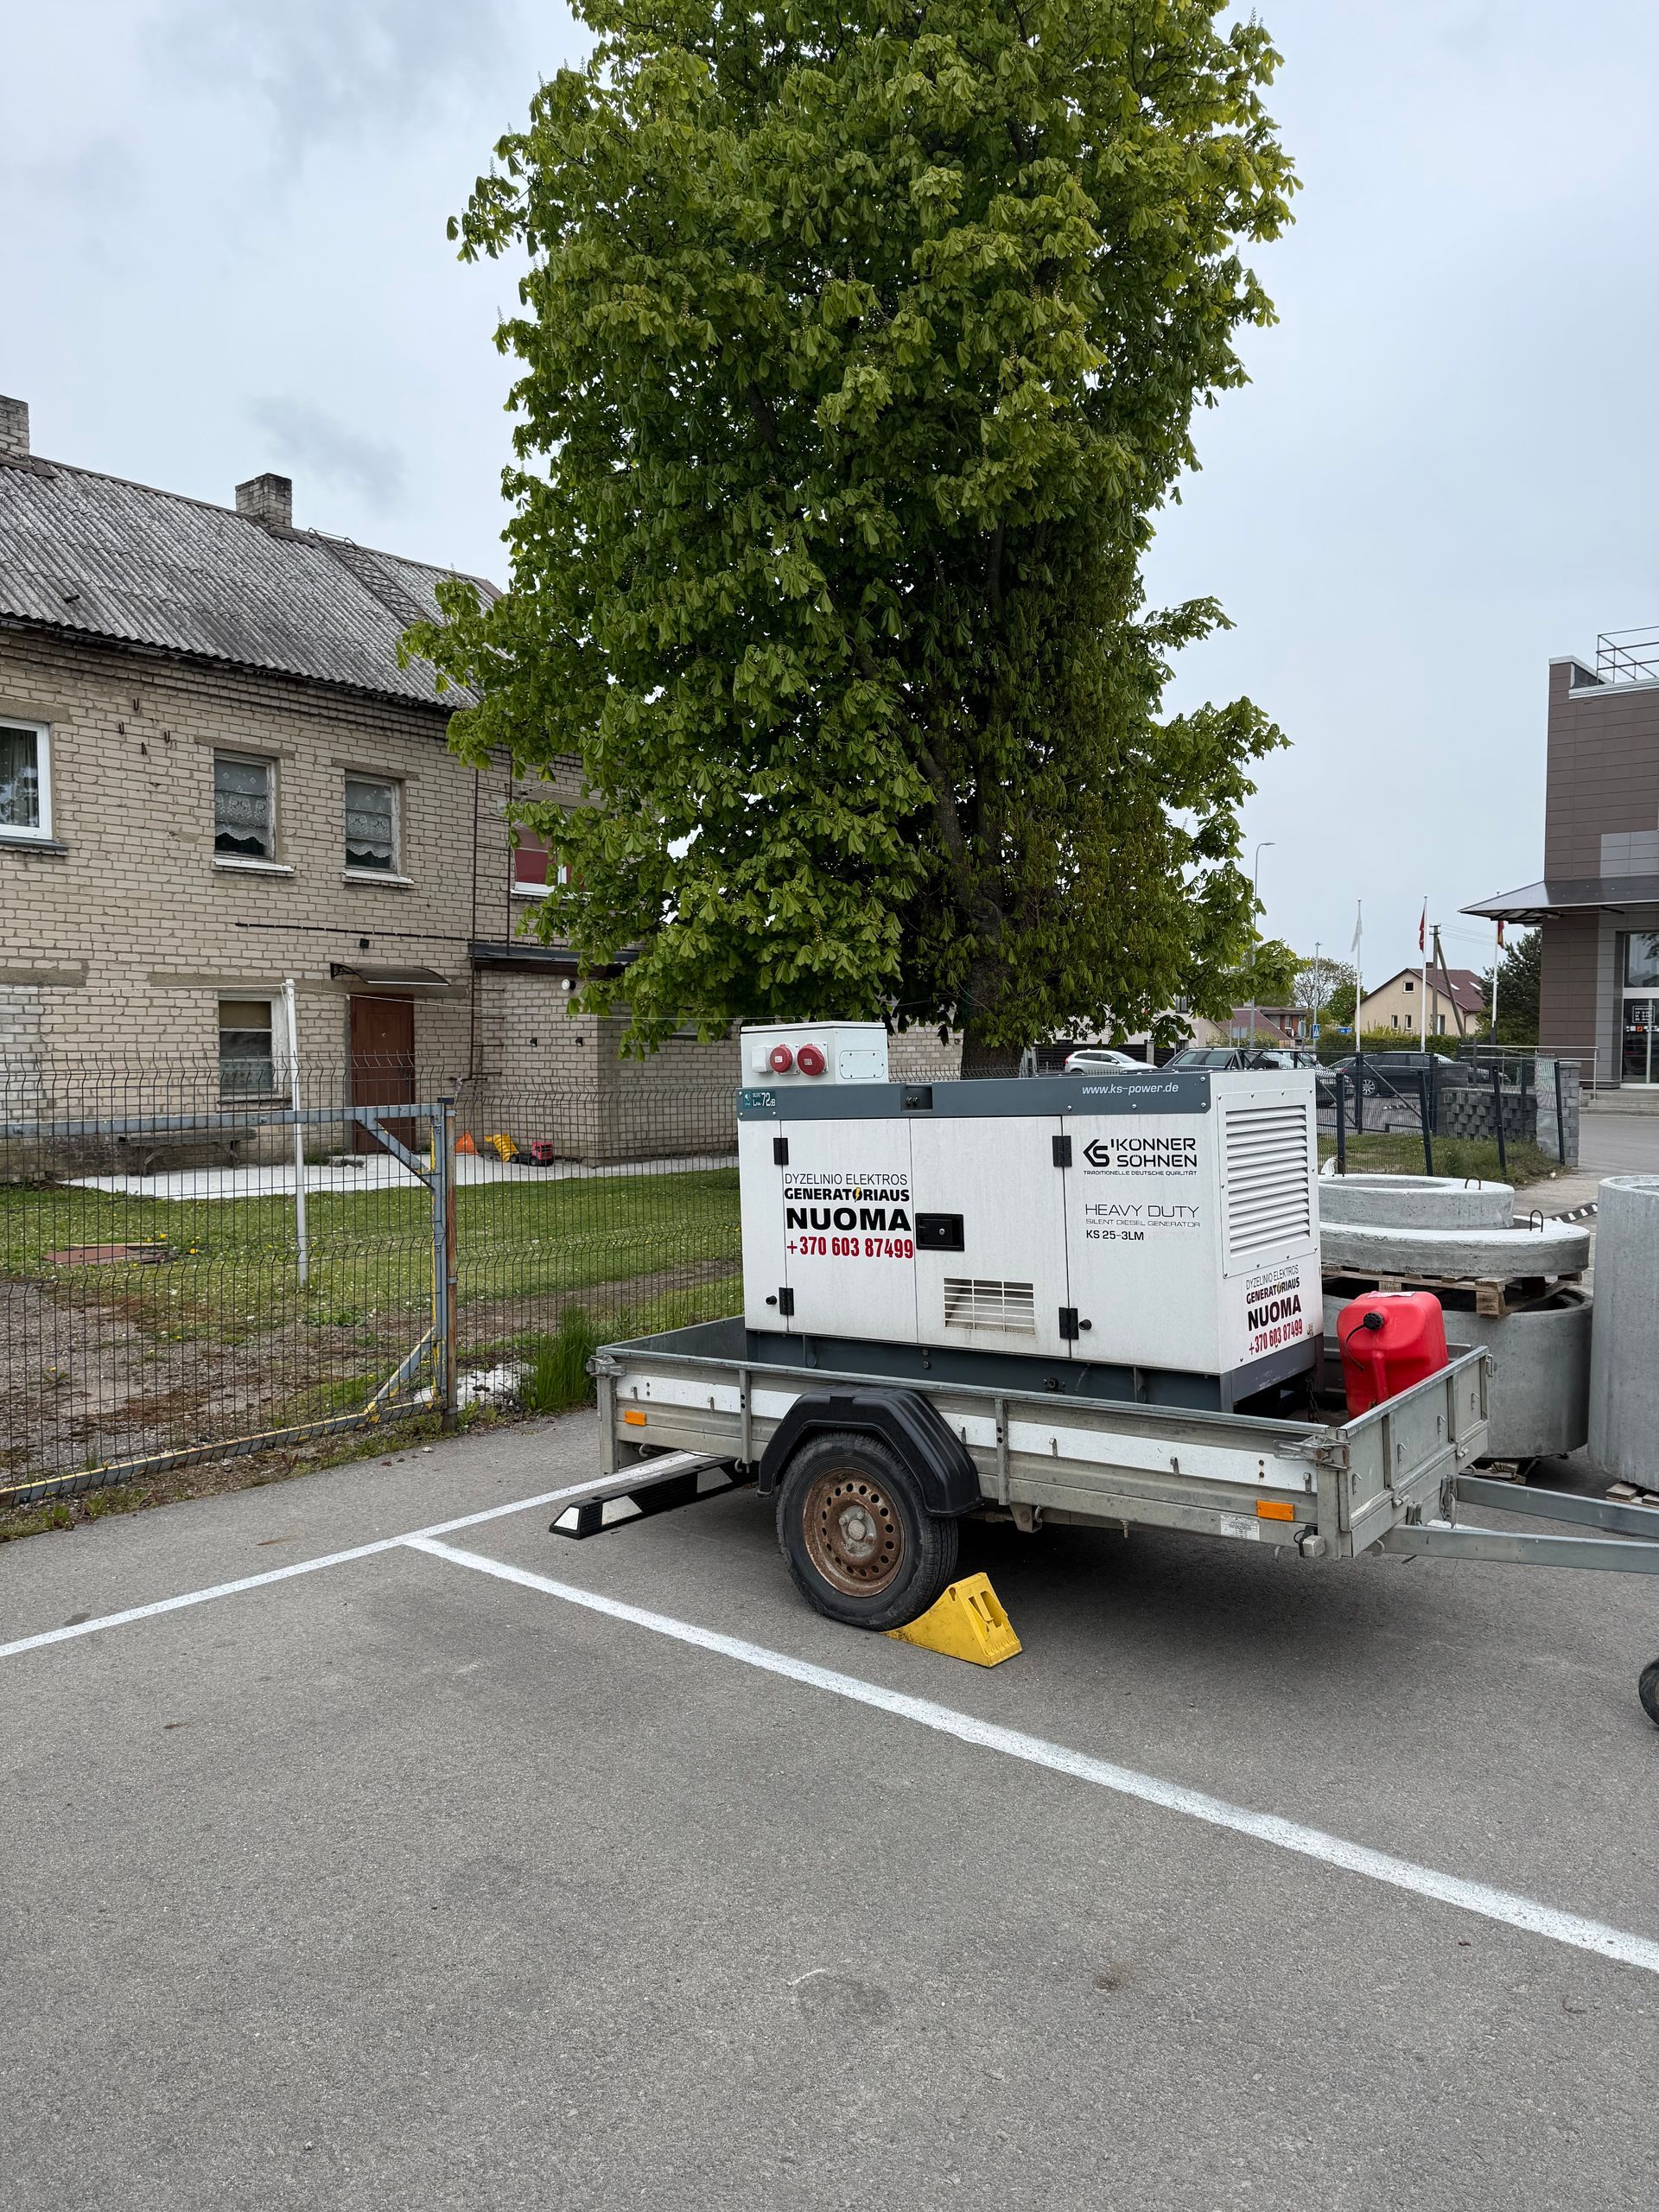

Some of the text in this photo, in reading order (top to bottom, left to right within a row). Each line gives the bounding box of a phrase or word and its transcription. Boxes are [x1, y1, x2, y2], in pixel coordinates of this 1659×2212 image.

[1082, 1082, 1179, 1096] www.ks-power.de
[1116, 1137, 1197, 1152] KÖNNER
[1116, 1154, 1198, 1168] SÖHNEN
[785, 1173, 908, 1185] DYZELINIO ELEKTROS
[784, 1186, 910, 1203] GENERATORIAUS
[786, 1207, 912, 1231] NUOMA
[1084, 1204, 1199, 1218] HEAVY DUTY
[1085, 1230, 1100, 1239] KS
[1102, 1230, 1145, 1241] 25-3LM
[786, 1236, 913, 1258] +370 603 87499
[1246, 1264, 1299, 1289] DYZELINIO ELEKTROS
[1246, 1277, 1300, 1304] GENERATORIAUS
[1248, 1294, 1301, 1331] NUOMA
[1249, 1319, 1303, 1355] +370 603 87499
